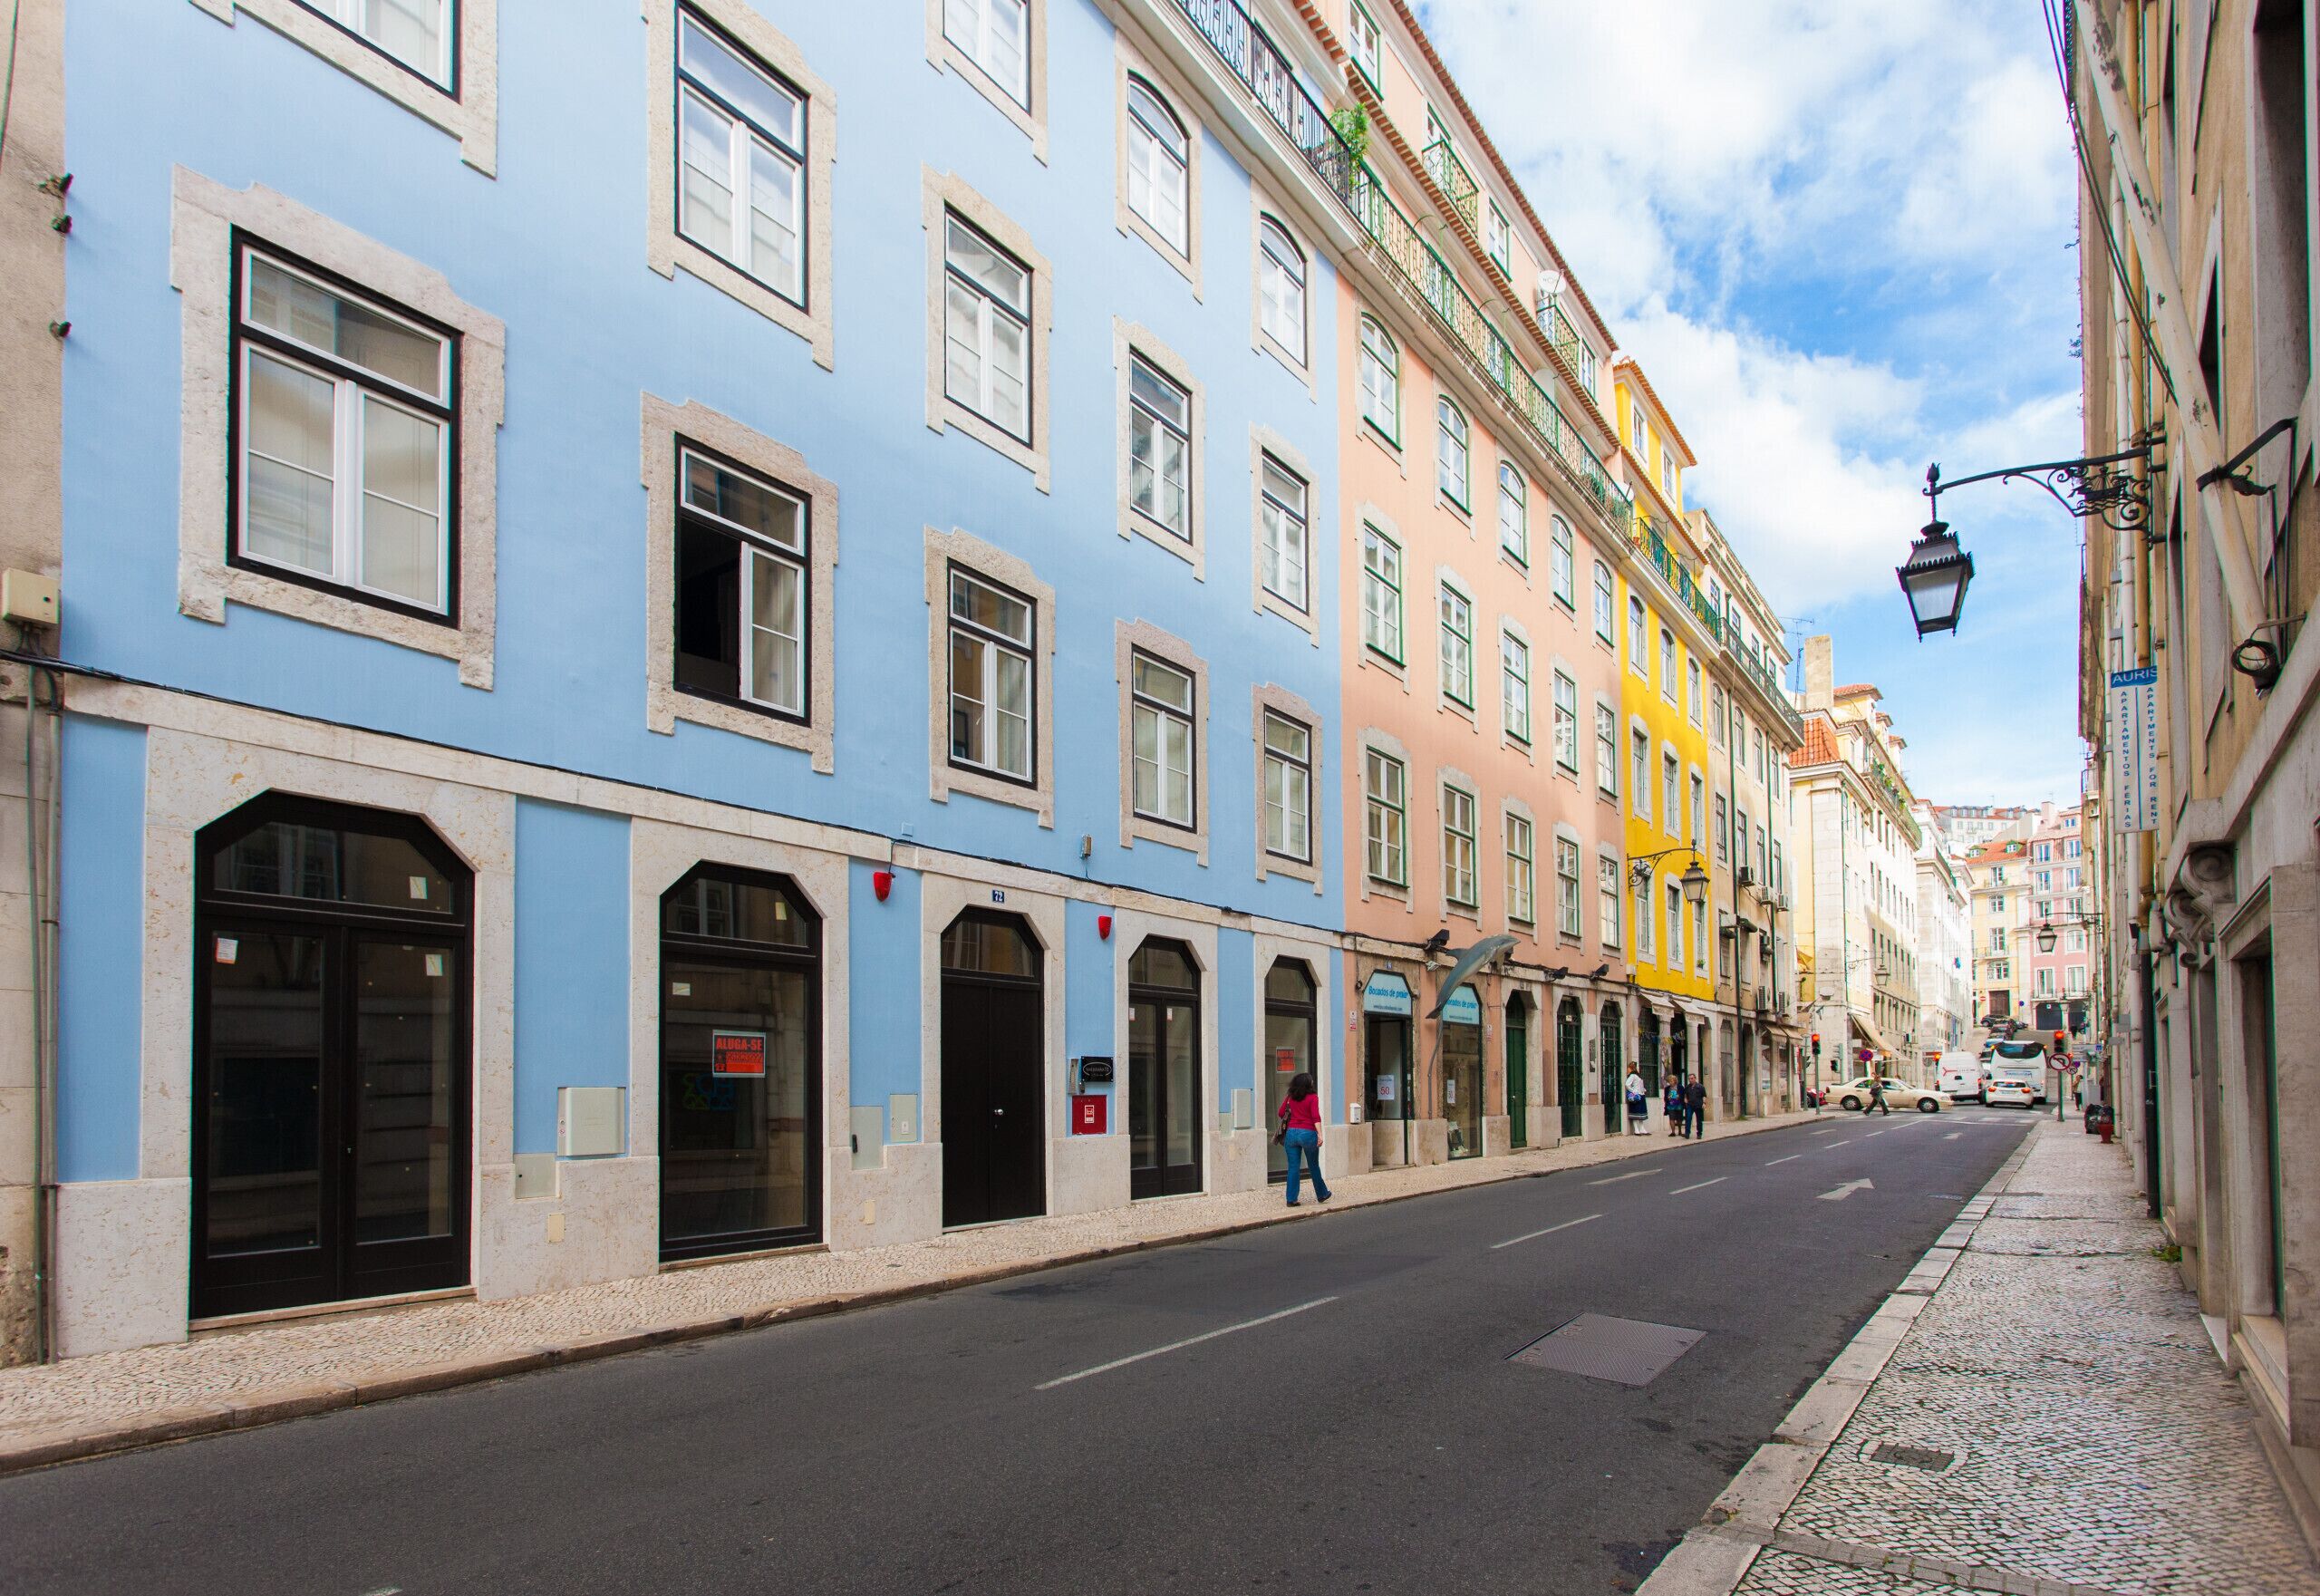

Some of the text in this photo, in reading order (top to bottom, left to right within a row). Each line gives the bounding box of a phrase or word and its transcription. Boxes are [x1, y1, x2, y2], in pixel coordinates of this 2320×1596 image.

[2121, 691, 2130, 777] APARTAMENTOS
[2146, 687, 2158, 825] APARTMENTS FOR RENT
[994, 891, 1003, 901] 72
[1368, 985, 1388, 996] Bocados
[1388, 988, 1396, 997] de
[716, 1037, 762, 1050] ALUGA-SE
